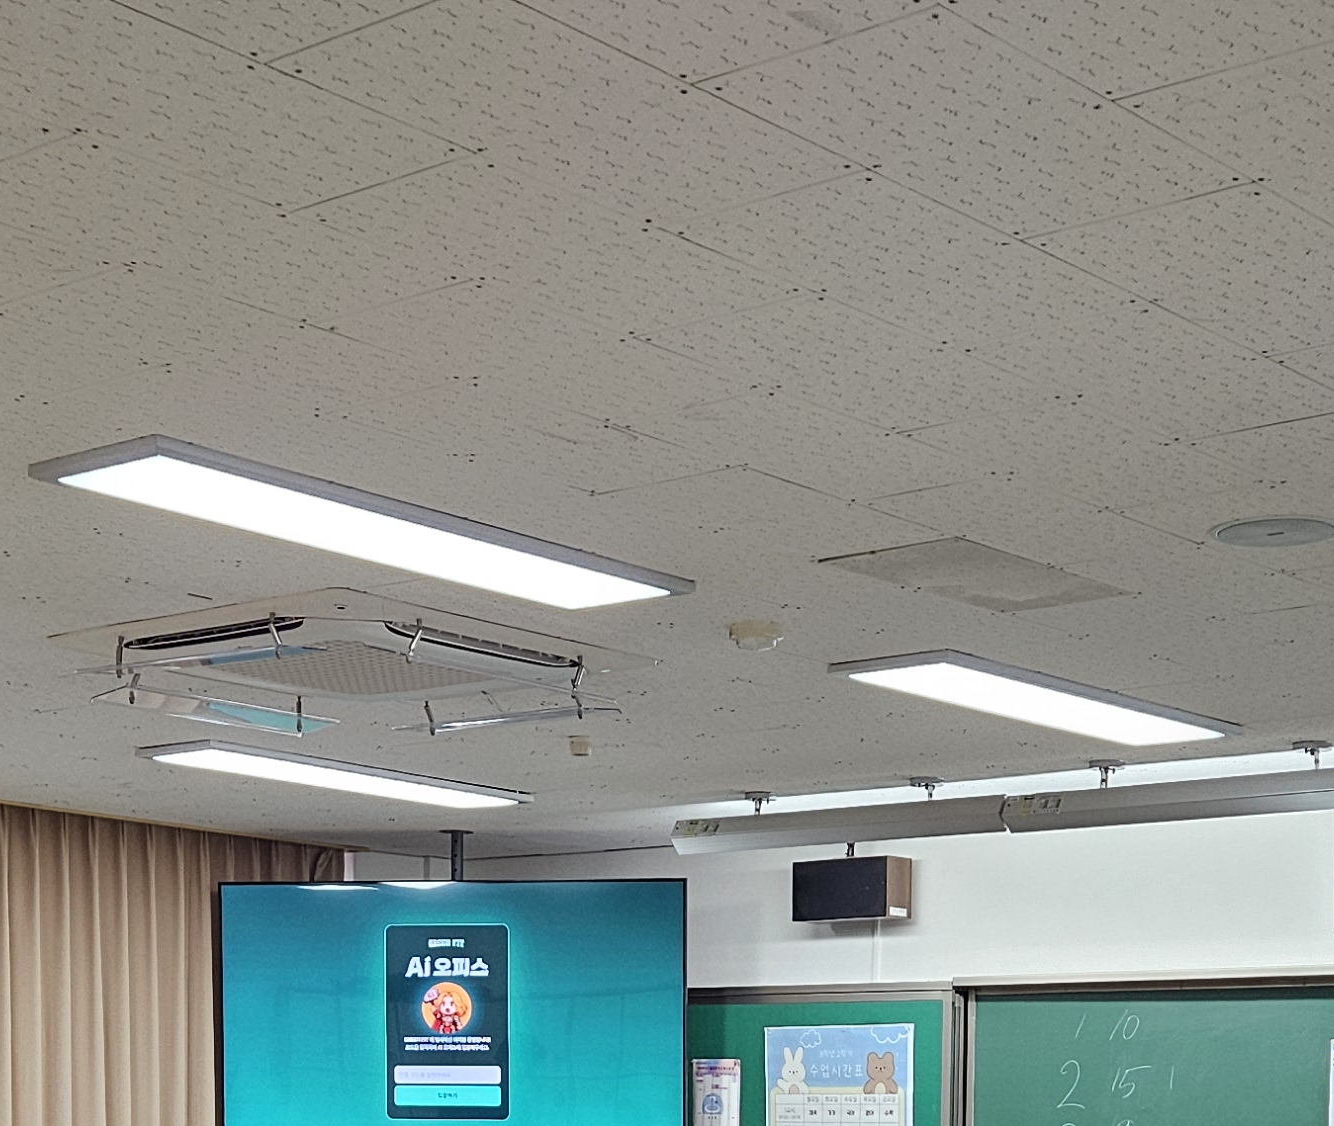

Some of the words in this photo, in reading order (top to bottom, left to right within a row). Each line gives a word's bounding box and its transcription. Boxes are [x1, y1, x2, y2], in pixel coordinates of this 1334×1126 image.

[433, 957, 489, 977] 오피스
[1109, 1010, 1141, 1041] 10
[810, 1064, 864, 1078] 수업시간표
[1056, 1060, 1086, 1110] 2
[1111, 1065, 1153, 1099] 15
